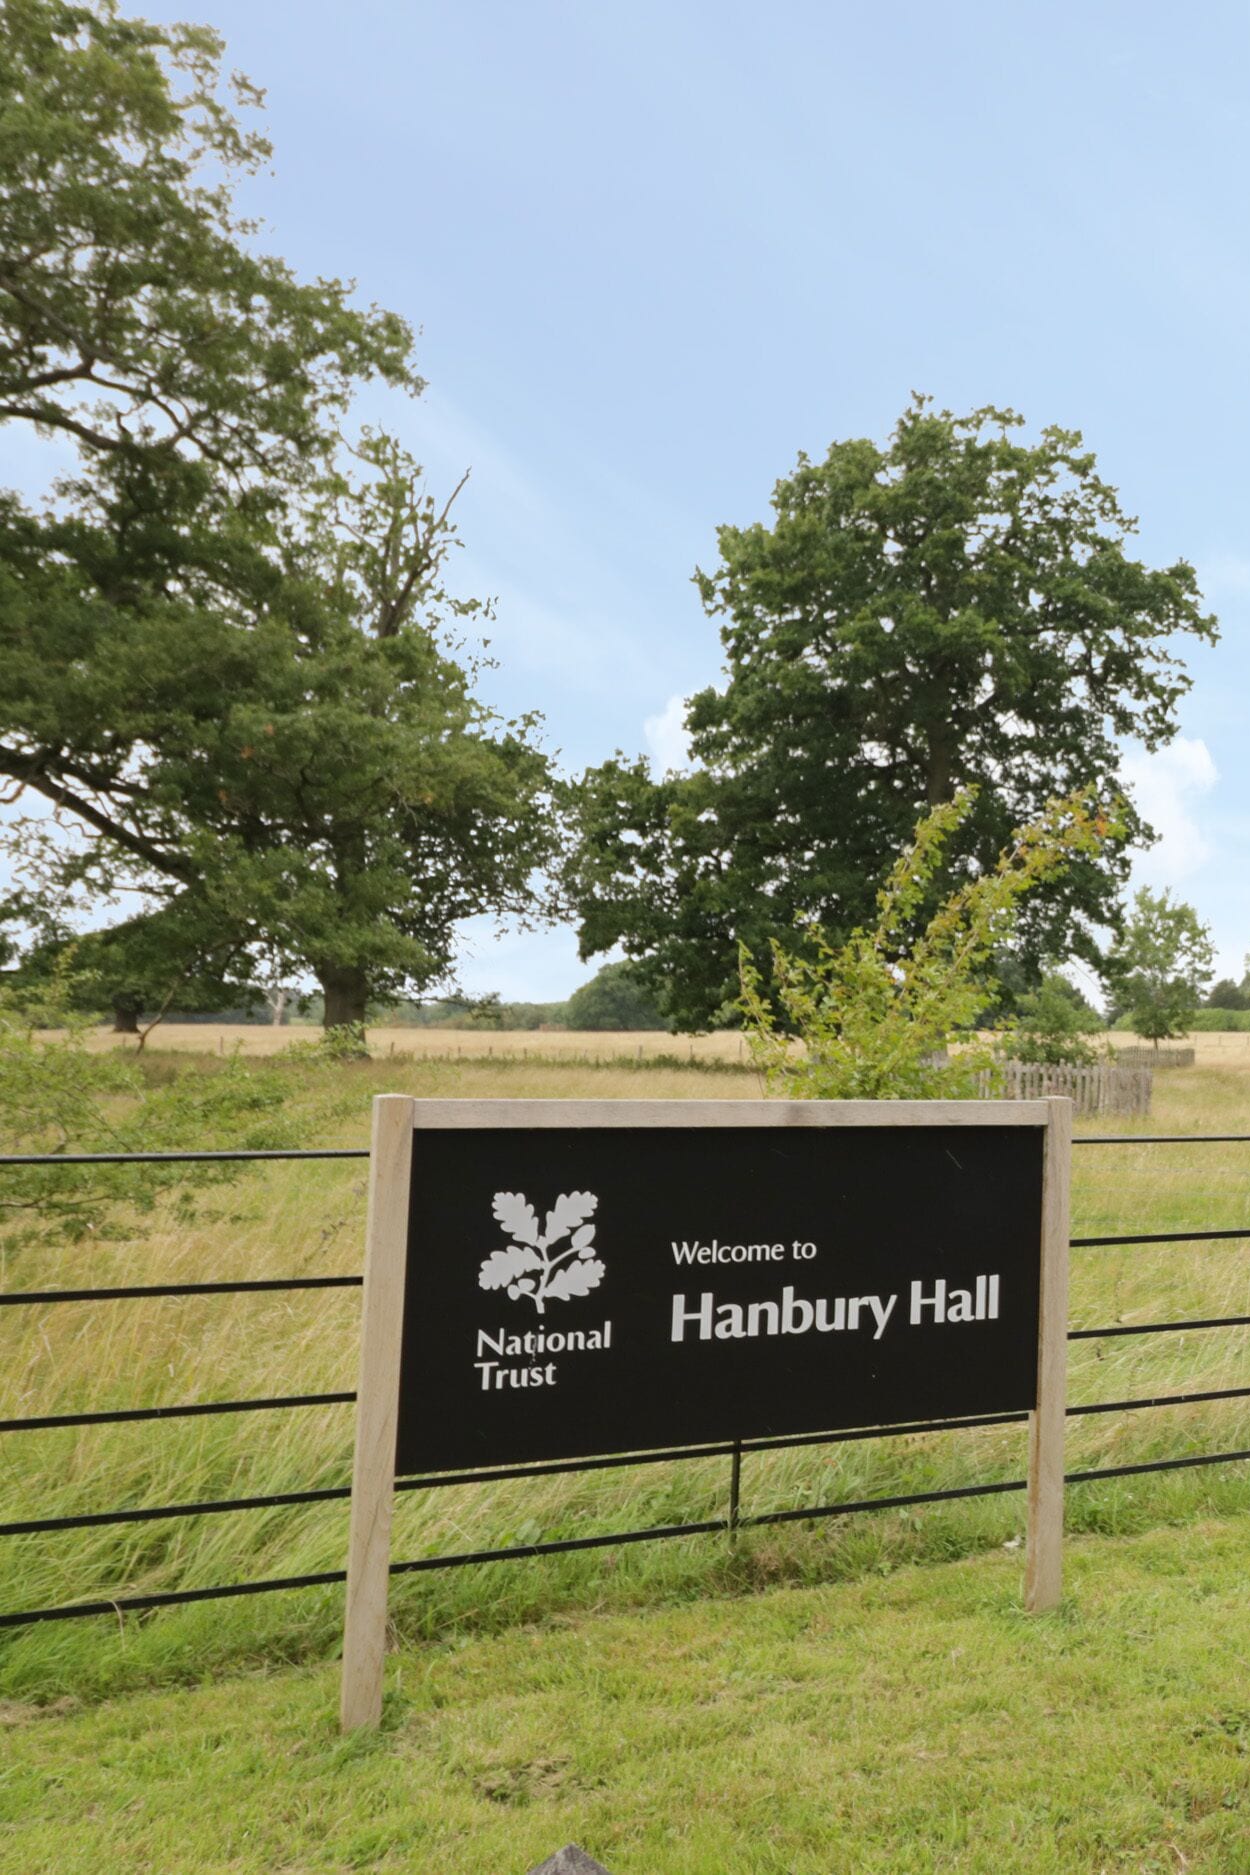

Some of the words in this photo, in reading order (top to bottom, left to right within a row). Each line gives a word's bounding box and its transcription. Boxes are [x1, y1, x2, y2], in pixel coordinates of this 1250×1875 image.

[671, 1239, 785, 1265] Welcome
[792, 1239, 818, 1261] to
[671, 1285, 898, 1342] Hanbury
[909, 1274, 1000, 1326] Hall
[476, 1320, 612, 1358] National
[474, 1361, 557, 1391] Trust
